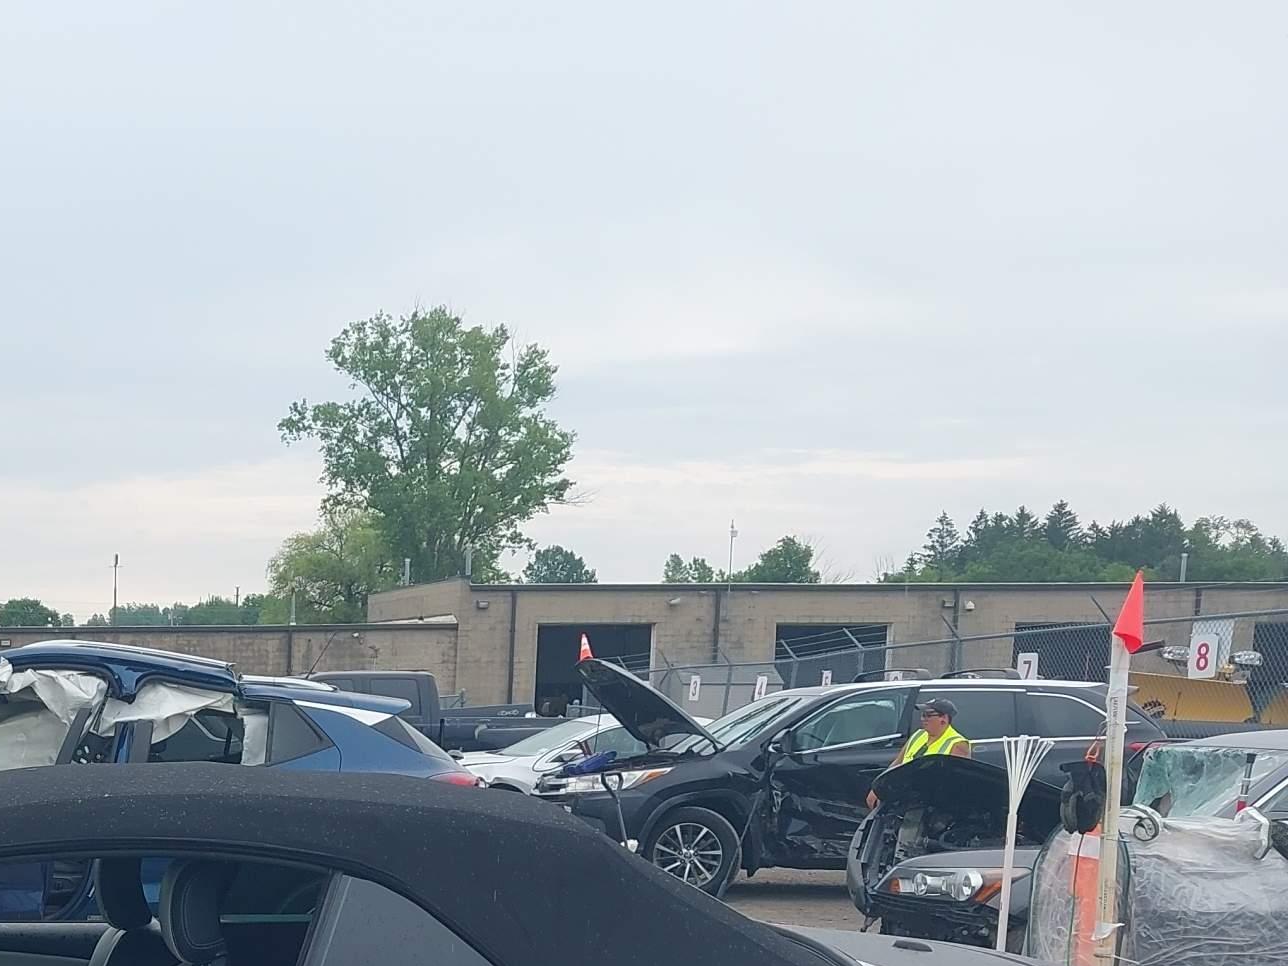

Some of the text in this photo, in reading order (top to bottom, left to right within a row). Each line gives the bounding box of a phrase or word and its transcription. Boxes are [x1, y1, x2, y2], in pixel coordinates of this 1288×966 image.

[1195, 642, 1210, 672] 8
[1022, 660, 1033, 680] 7
[691, 680, 698, 697] 3
